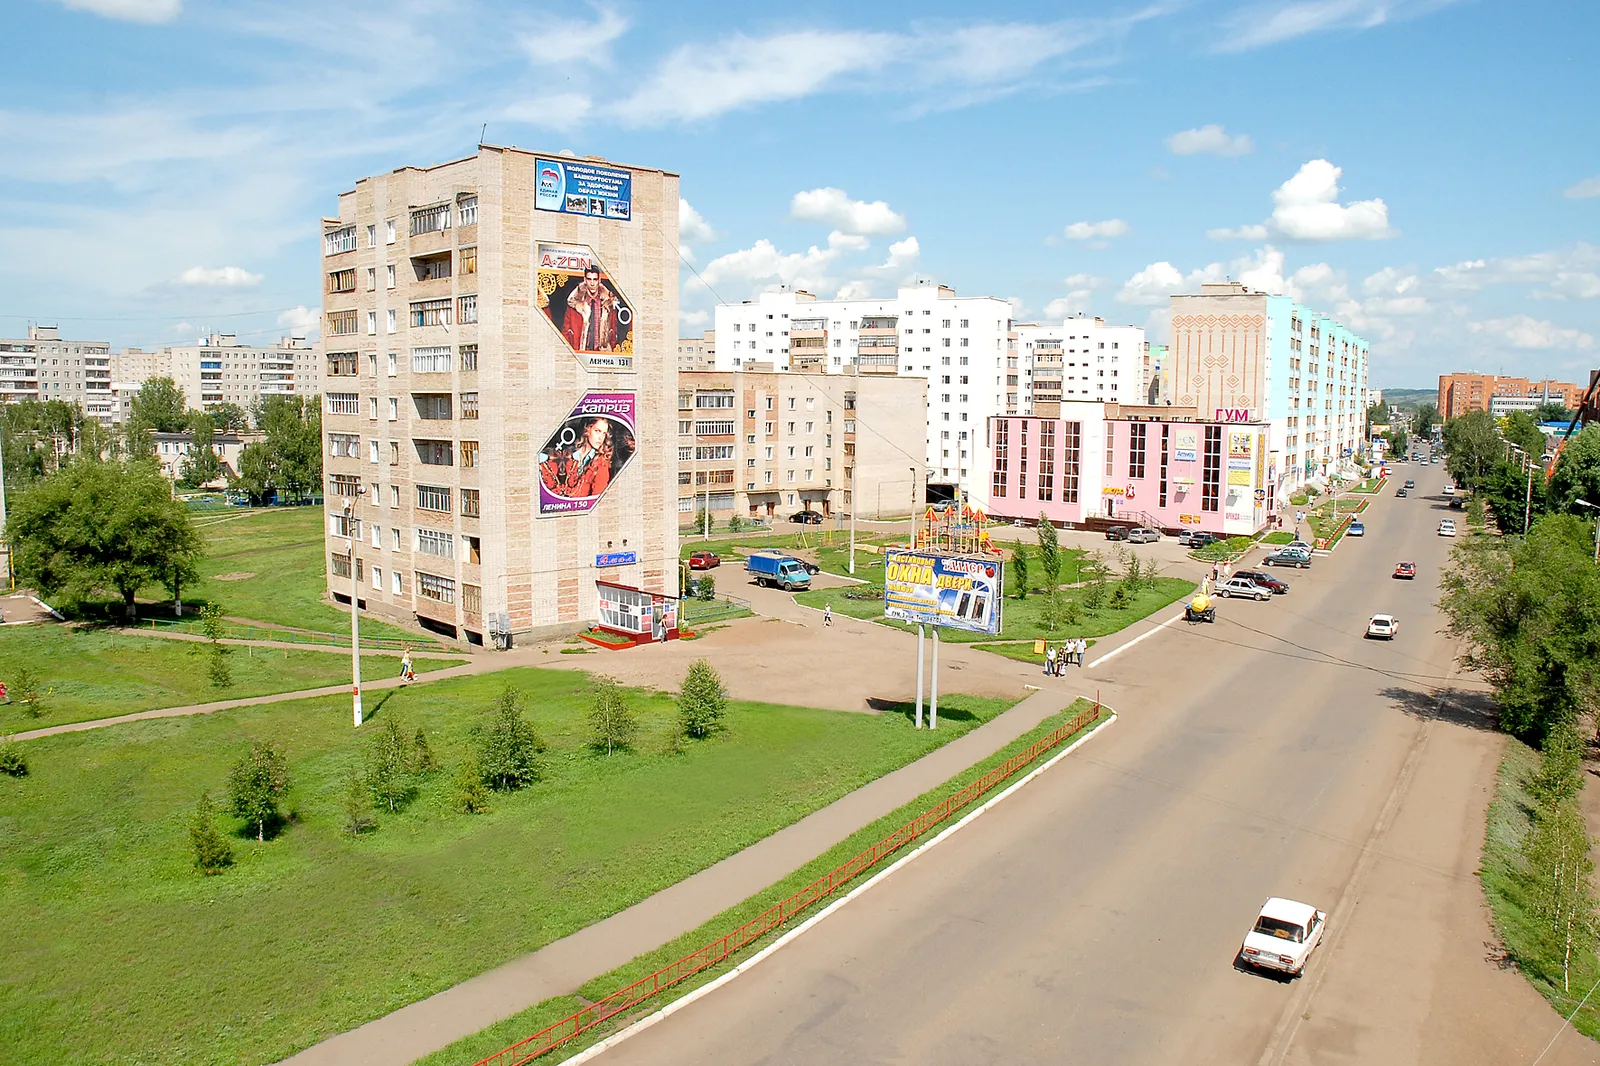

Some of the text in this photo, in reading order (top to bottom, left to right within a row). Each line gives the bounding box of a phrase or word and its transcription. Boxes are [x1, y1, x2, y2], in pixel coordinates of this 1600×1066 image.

[589, 358, 614, 366] ЛЕНИНА
[1215, 408, 1249, 422] ГУМ
[542, 500, 588, 511] ЛЕНИНА 150
[887, 562, 933, 586] ОКНА
[935, 575, 973, 592] ДВЕРИ
